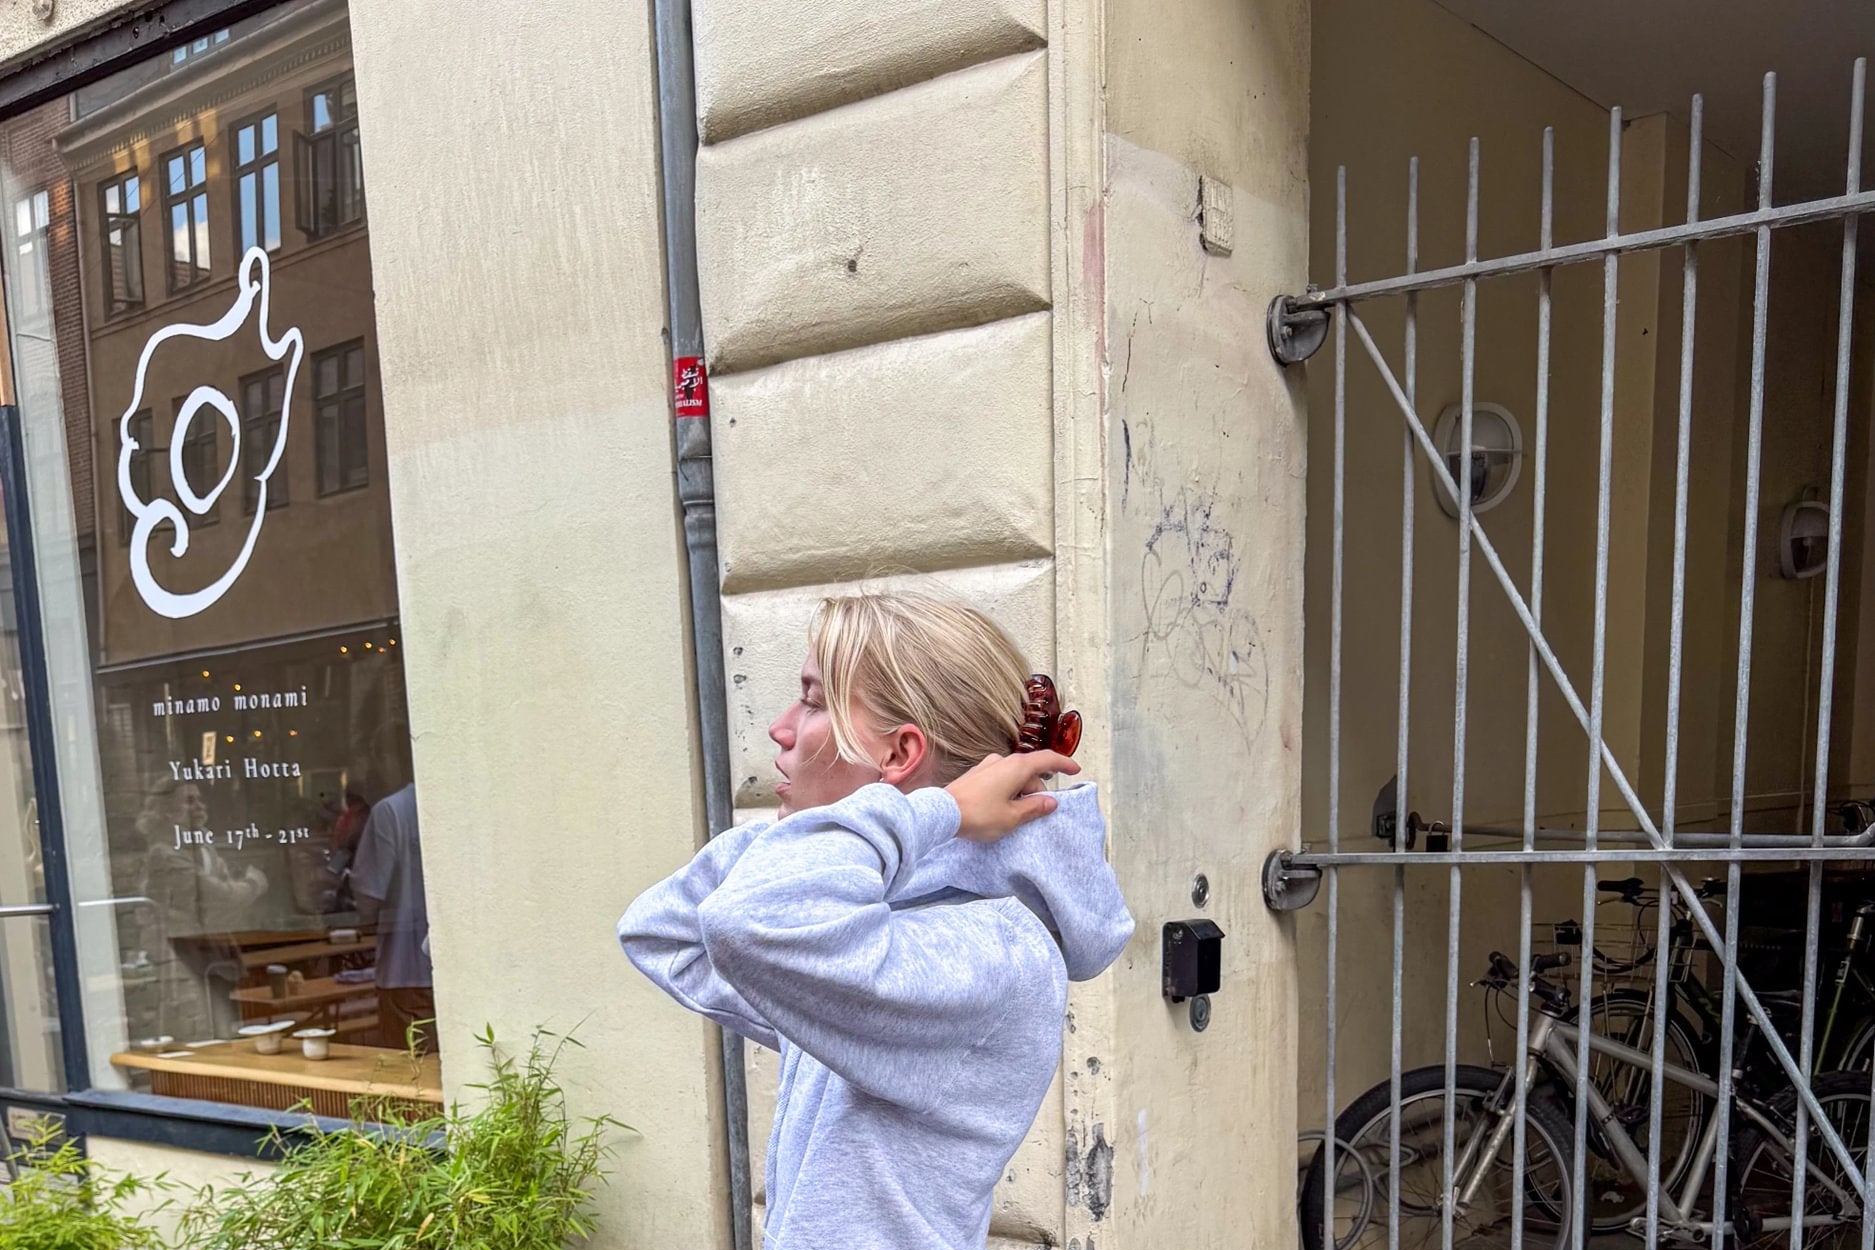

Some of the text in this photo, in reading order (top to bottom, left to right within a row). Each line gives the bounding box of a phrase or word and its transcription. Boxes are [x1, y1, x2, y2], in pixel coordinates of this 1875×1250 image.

[153, 685, 307, 716] minamo monami
[169, 758, 301, 780] Yukari Hotta
[173, 823, 214, 850] June
